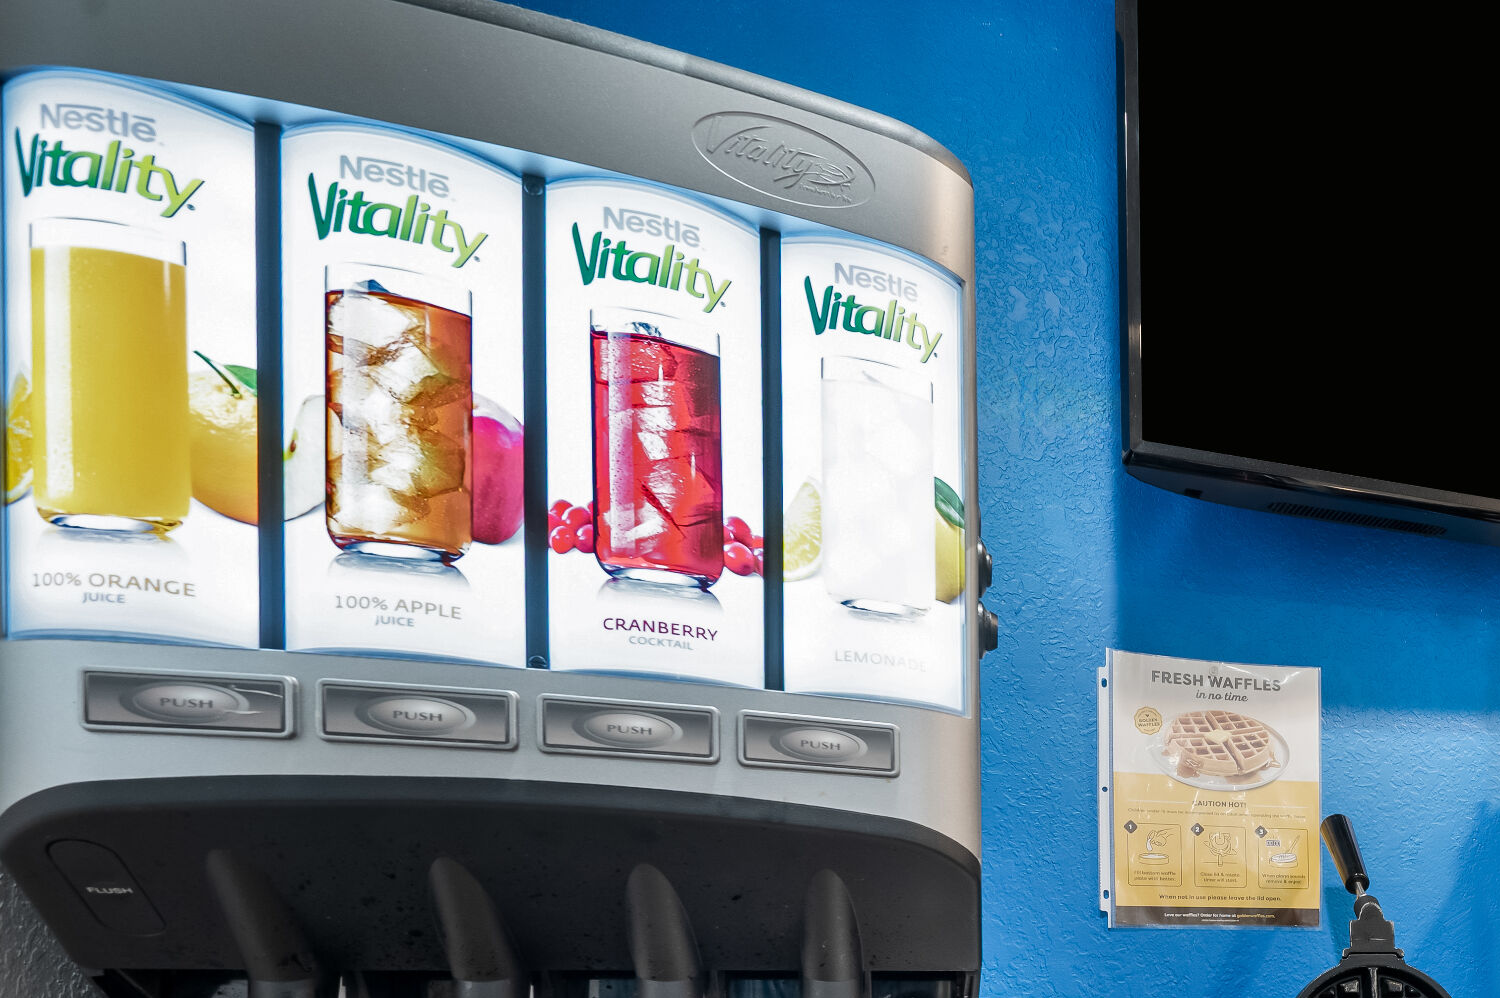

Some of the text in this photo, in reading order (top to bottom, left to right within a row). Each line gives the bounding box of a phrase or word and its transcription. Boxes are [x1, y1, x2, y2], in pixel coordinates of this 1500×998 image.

[15, 126, 205, 218] Vitality
[307, 172, 489, 268] Vitality
[571, 221, 732, 314] Vitality
[804, 275, 943, 364] Vitality
[32, 572, 196, 598] 100% ORANGE
[82, 591, 127, 604] JUICE
[335, 595, 463, 620] 100% APPLE
[374, 614, 415, 627] JUICE
[603, 617, 719, 642] CRANBERRY
[628, 635, 694, 651] COCKTAIL
[834, 649, 928, 673] LEMONADE
[1152, 670, 1281, 692] FRESH WAFFLES
[159, 697, 214, 710] PUSH
[1195, 689, 1207, 700] in
[1208, 693, 1223, 701] no
[392, 710, 443, 723] PUSH
[606, 723, 653, 736] PUSH
[800, 739, 841, 752] PUSH
[86, 886, 134, 895] FLUSH
